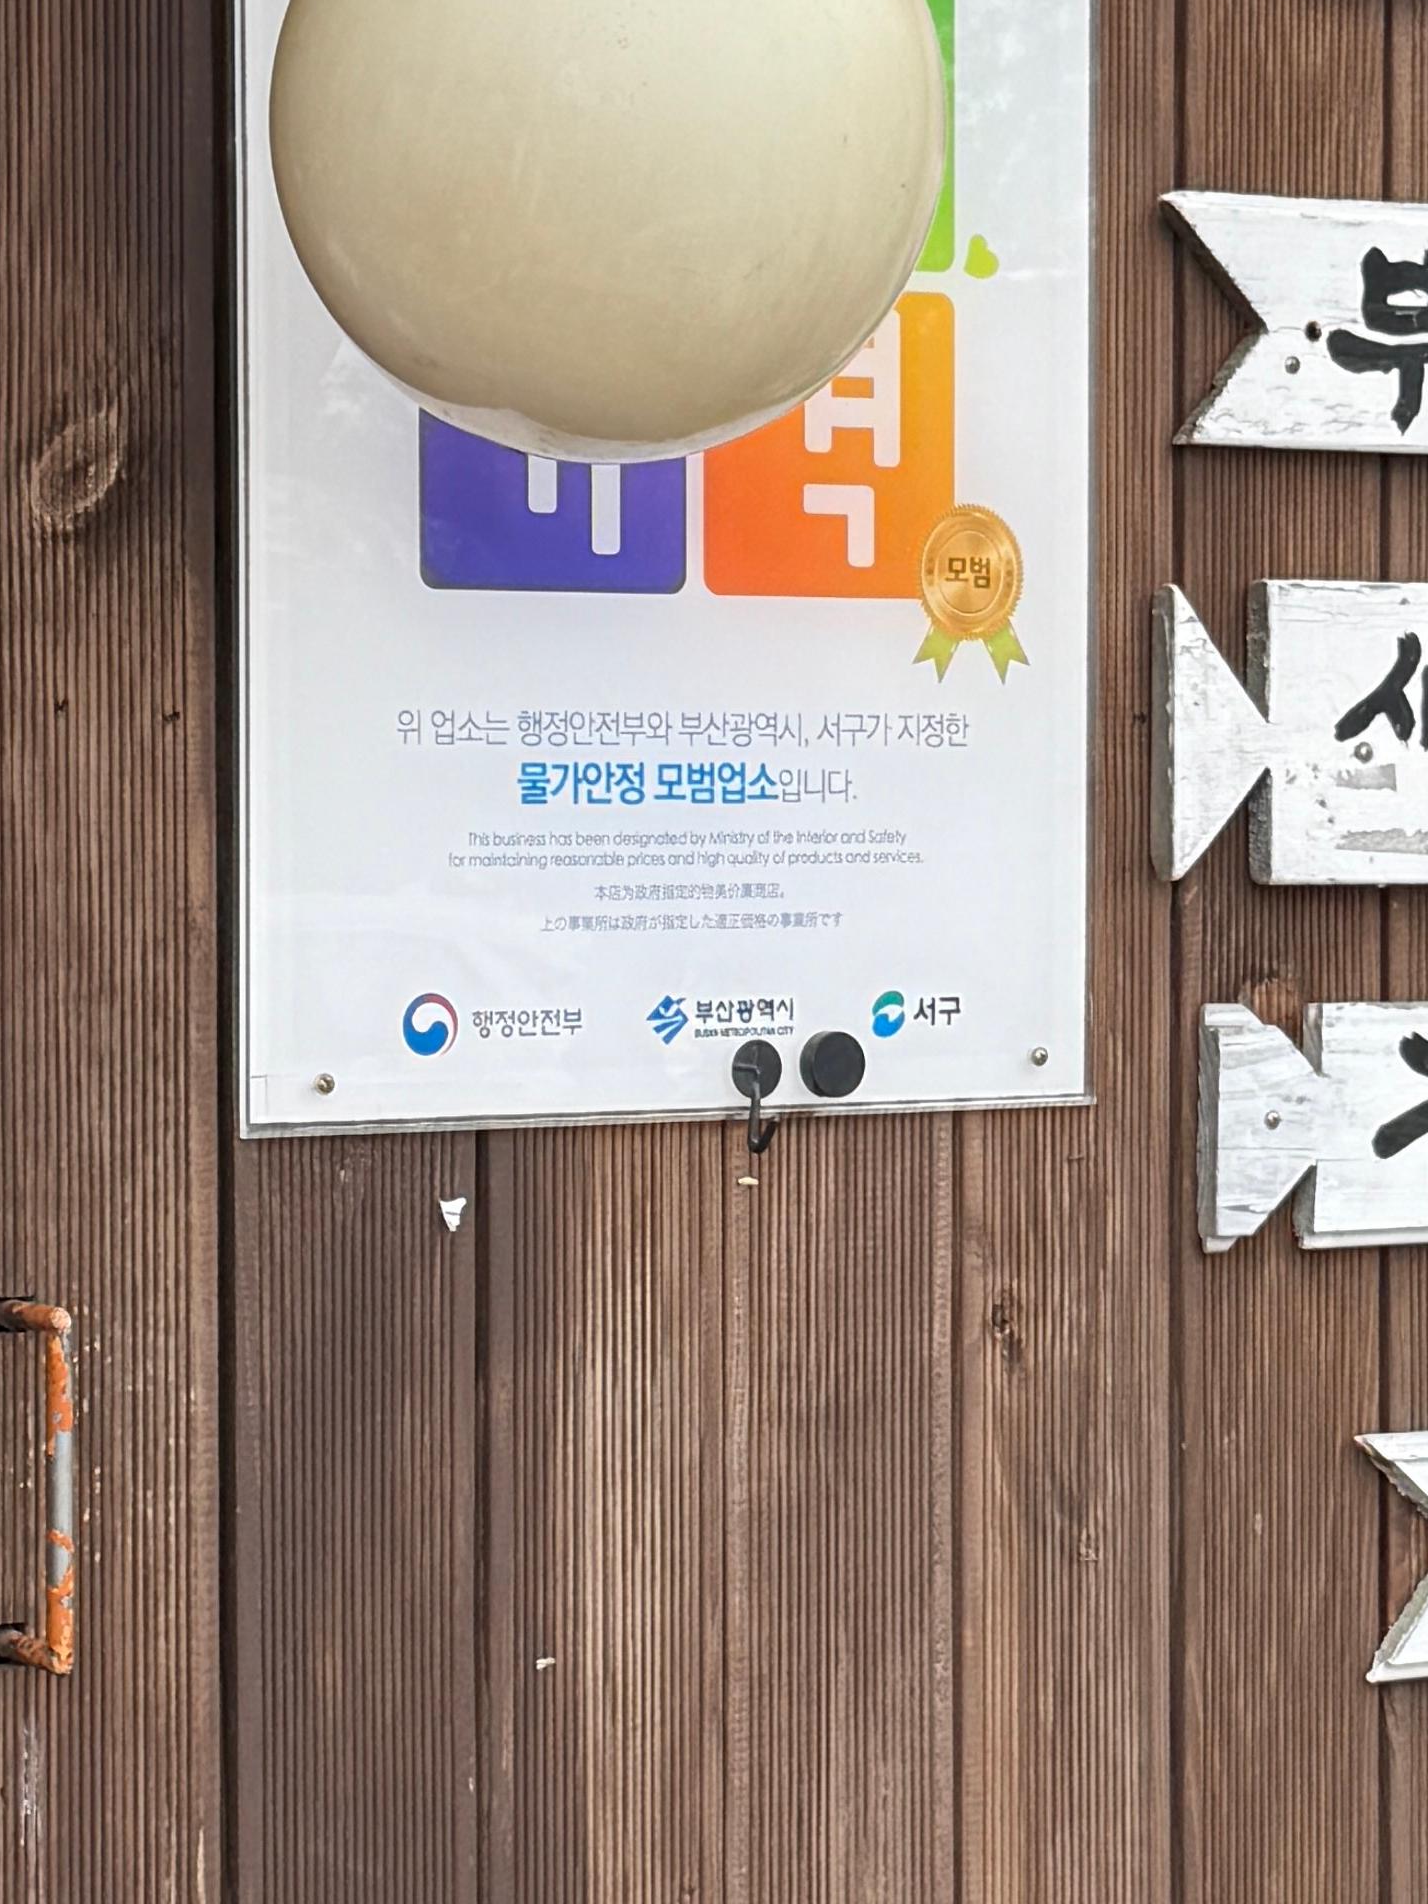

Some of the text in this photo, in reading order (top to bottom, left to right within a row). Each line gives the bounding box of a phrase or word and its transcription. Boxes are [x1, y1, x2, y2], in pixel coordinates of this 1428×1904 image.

[945, 553, 992, 589] 모범
[397, 709, 970, 748] 위 업소는 행정안전부와 부산광역시, 서구가 지정한
[517, 761, 858, 805] 물가안정 모범업소입니다.
[468, 829, 907, 849] This business has been designated by Ministry of the Interior and Safety
[447, 850, 925, 871] for maintaining reasonable prices and high quality of products and services.
[471, 1007, 583, 1039] 행정안전부
[694, 997, 795, 1025] 부산광역시
[912, 996, 962, 1027] 서구
